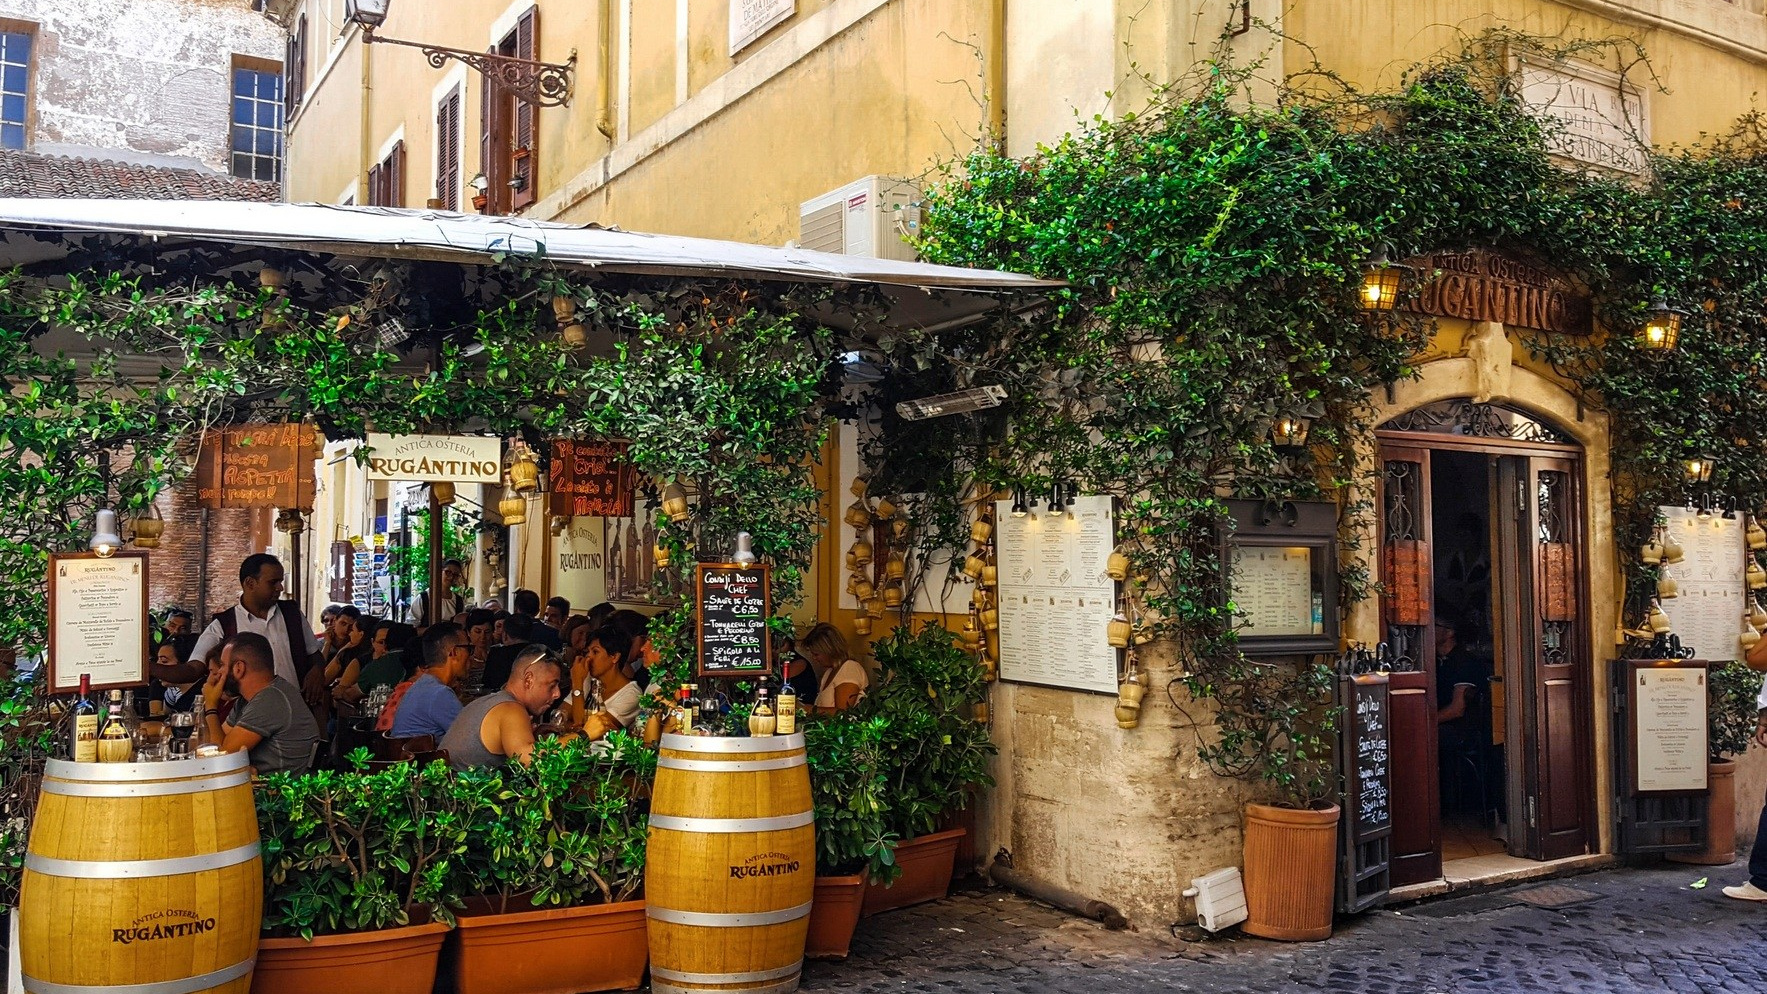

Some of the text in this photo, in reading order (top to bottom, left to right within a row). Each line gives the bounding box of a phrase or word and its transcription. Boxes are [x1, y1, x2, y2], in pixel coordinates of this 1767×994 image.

[1568, 84, 1599, 112] VIA
[395, 440, 476, 458] ANTICA OSTERIA
[370, 455, 498, 478] RUGANTINO
[579, 527, 598, 547] OSTERIA
[560, 552, 602, 573] RUGANTINO
[744, 852, 790, 865] ANTICA OSTERIA
[730, 861, 799, 879] RUGANTINO
[131, 909, 199, 927] ANTICA OSTERIA
[112, 918, 216, 944] RUGANTINO
